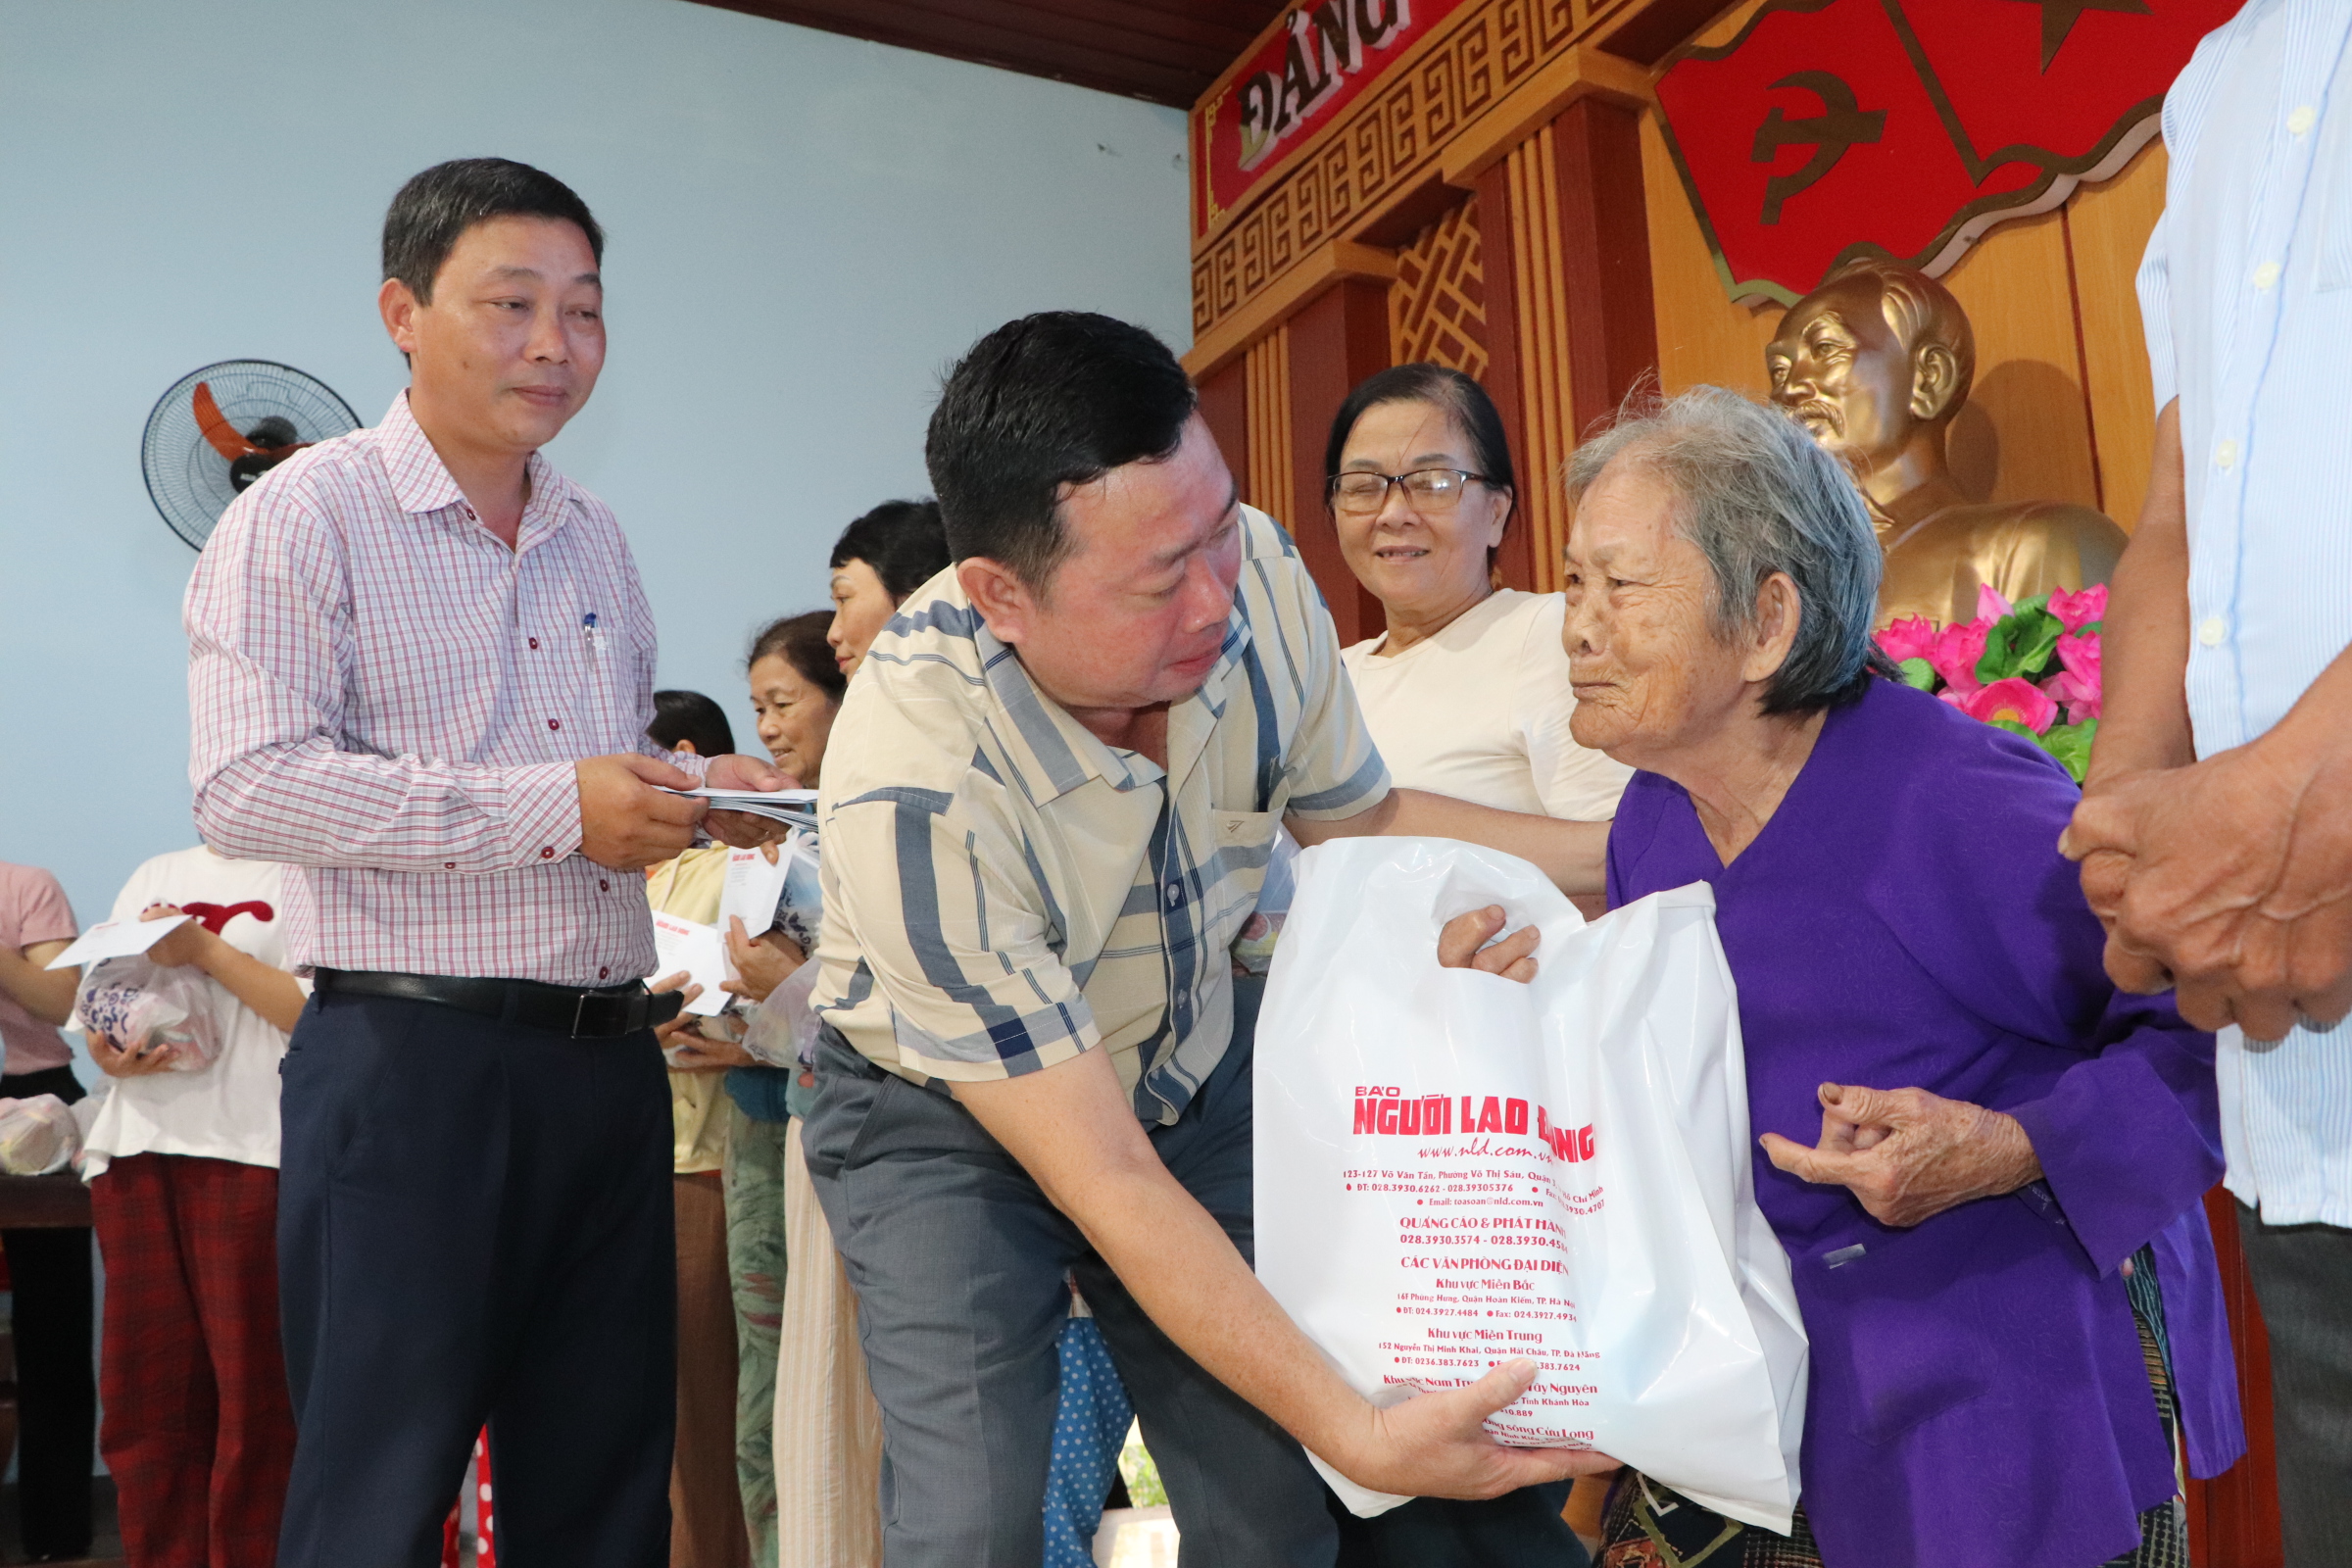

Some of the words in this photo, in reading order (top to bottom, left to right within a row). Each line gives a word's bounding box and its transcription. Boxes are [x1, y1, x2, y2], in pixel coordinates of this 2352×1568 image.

[1355, 1086, 1400, 1097] BÁO
[1353, 1094, 1451, 1135] NGƯỜI
[1461, 1096, 1529, 1135] LAO
[1538, 1104, 1594, 1163] ĐNG
[1372, 1184, 1441, 1193] 028.3930.6262
[1397, 1170, 1414, 1179] Văn
[1439, 1170, 1468, 1180] Phường
[1486, 1170, 1500, 1179] Thị
[1503, 1170, 1524, 1179] Sáu,
[1528, 1172, 1550, 1184] Quận
[1589, 1186, 1603, 1200] Minh
[1454, 1197, 1544, 1207] toasoan@nld.com.vn
[1450, 1216, 1478, 1228] CÁO
[1481, 1218, 1490, 1228] &
[1493, 1216, 1533, 1229] PHÁT
[1399, 1235, 1480, 1245] 028.3930.3574
[1400, 1255, 1430, 1268] CÁC
[1433, 1256, 1458, 1269] VĂN
[1460, 1256, 1511, 1270] PHÒNG
[1514, 1259, 1538, 1273] ĐẠI
[1541, 1260, 1569, 1276] DIỆN
[1436, 1278, 1458, 1289] Khu
[1460, 1280, 1479, 1291] vực
[1481, 1279, 1510, 1290] Miền
[1513, 1279, 1535, 1291] Bắc
[1462, 1295, 1483, 1304] Quận
[1415, 1307, 1478, 1317] 024.3927.4484
[1428, 1328, 1449, 1339] Khu
[1452, 1330, 1472, 1341] vực
[1474, 1329, 1503, 1341] Miền
[1506, 1330, 1543, 1344] Trung
[1394, 1343, 1421, 1352] Nguyễn
[1423, 1345, 1435, 1353] Thị
[1459, 1346, 1481, 1354] Khai,
[1484, 1347, 1506, 1355] Quận
[1526, 1348, 1548, 1356] Châu,
[1415, 1357, 1479, 1367] 0236.383.7623
[1384, 1375, 1404, 1384] Khu
[1426, 1378, 1452, 1387] Nam
[1549, 1383, 1598, 1396] Nguyên
[1521, 1396, 1539, 1405] Tỉnh
[1562, 1429, 1594, 1440] Long
